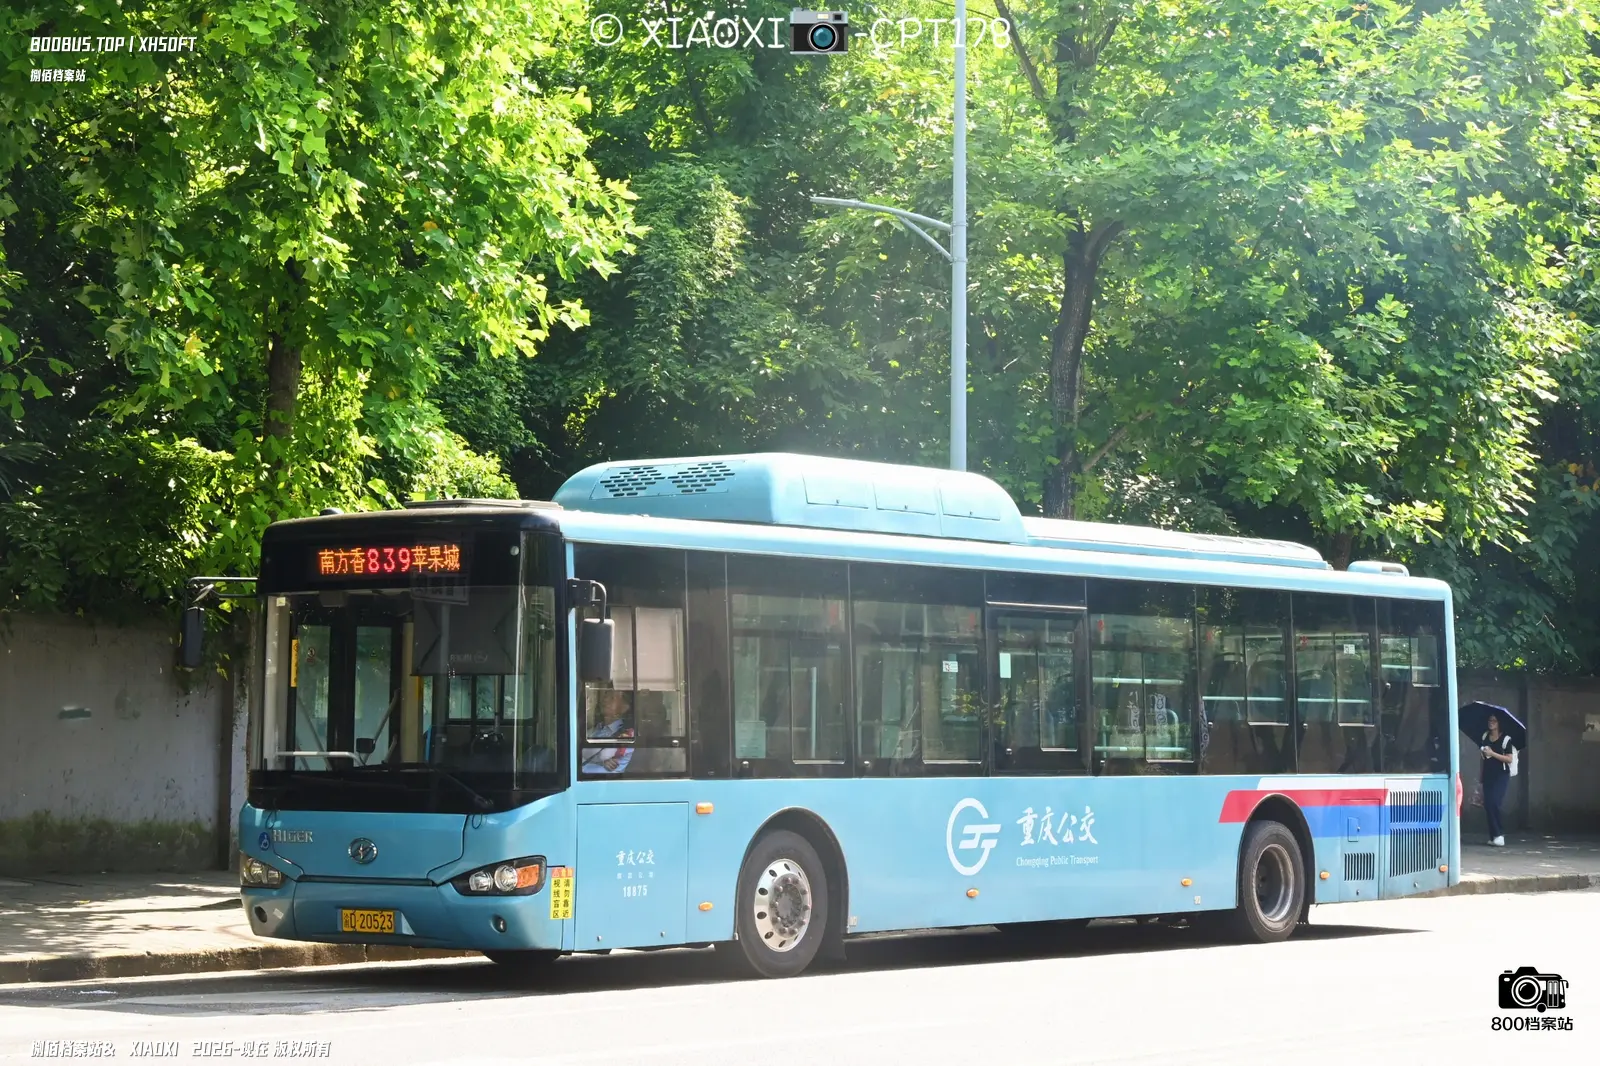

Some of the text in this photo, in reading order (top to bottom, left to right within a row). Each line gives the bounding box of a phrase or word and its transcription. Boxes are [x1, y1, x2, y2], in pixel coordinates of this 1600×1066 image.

[367, 548, 410, 573] 839
[1016, 805, 1098, 846] 重庆公交
[272, 829, 314, 842] HIGER
[616, 849, 655, 866] 重庆公交
[1016, 854, 1099, 868] Chongqing Public Transport
